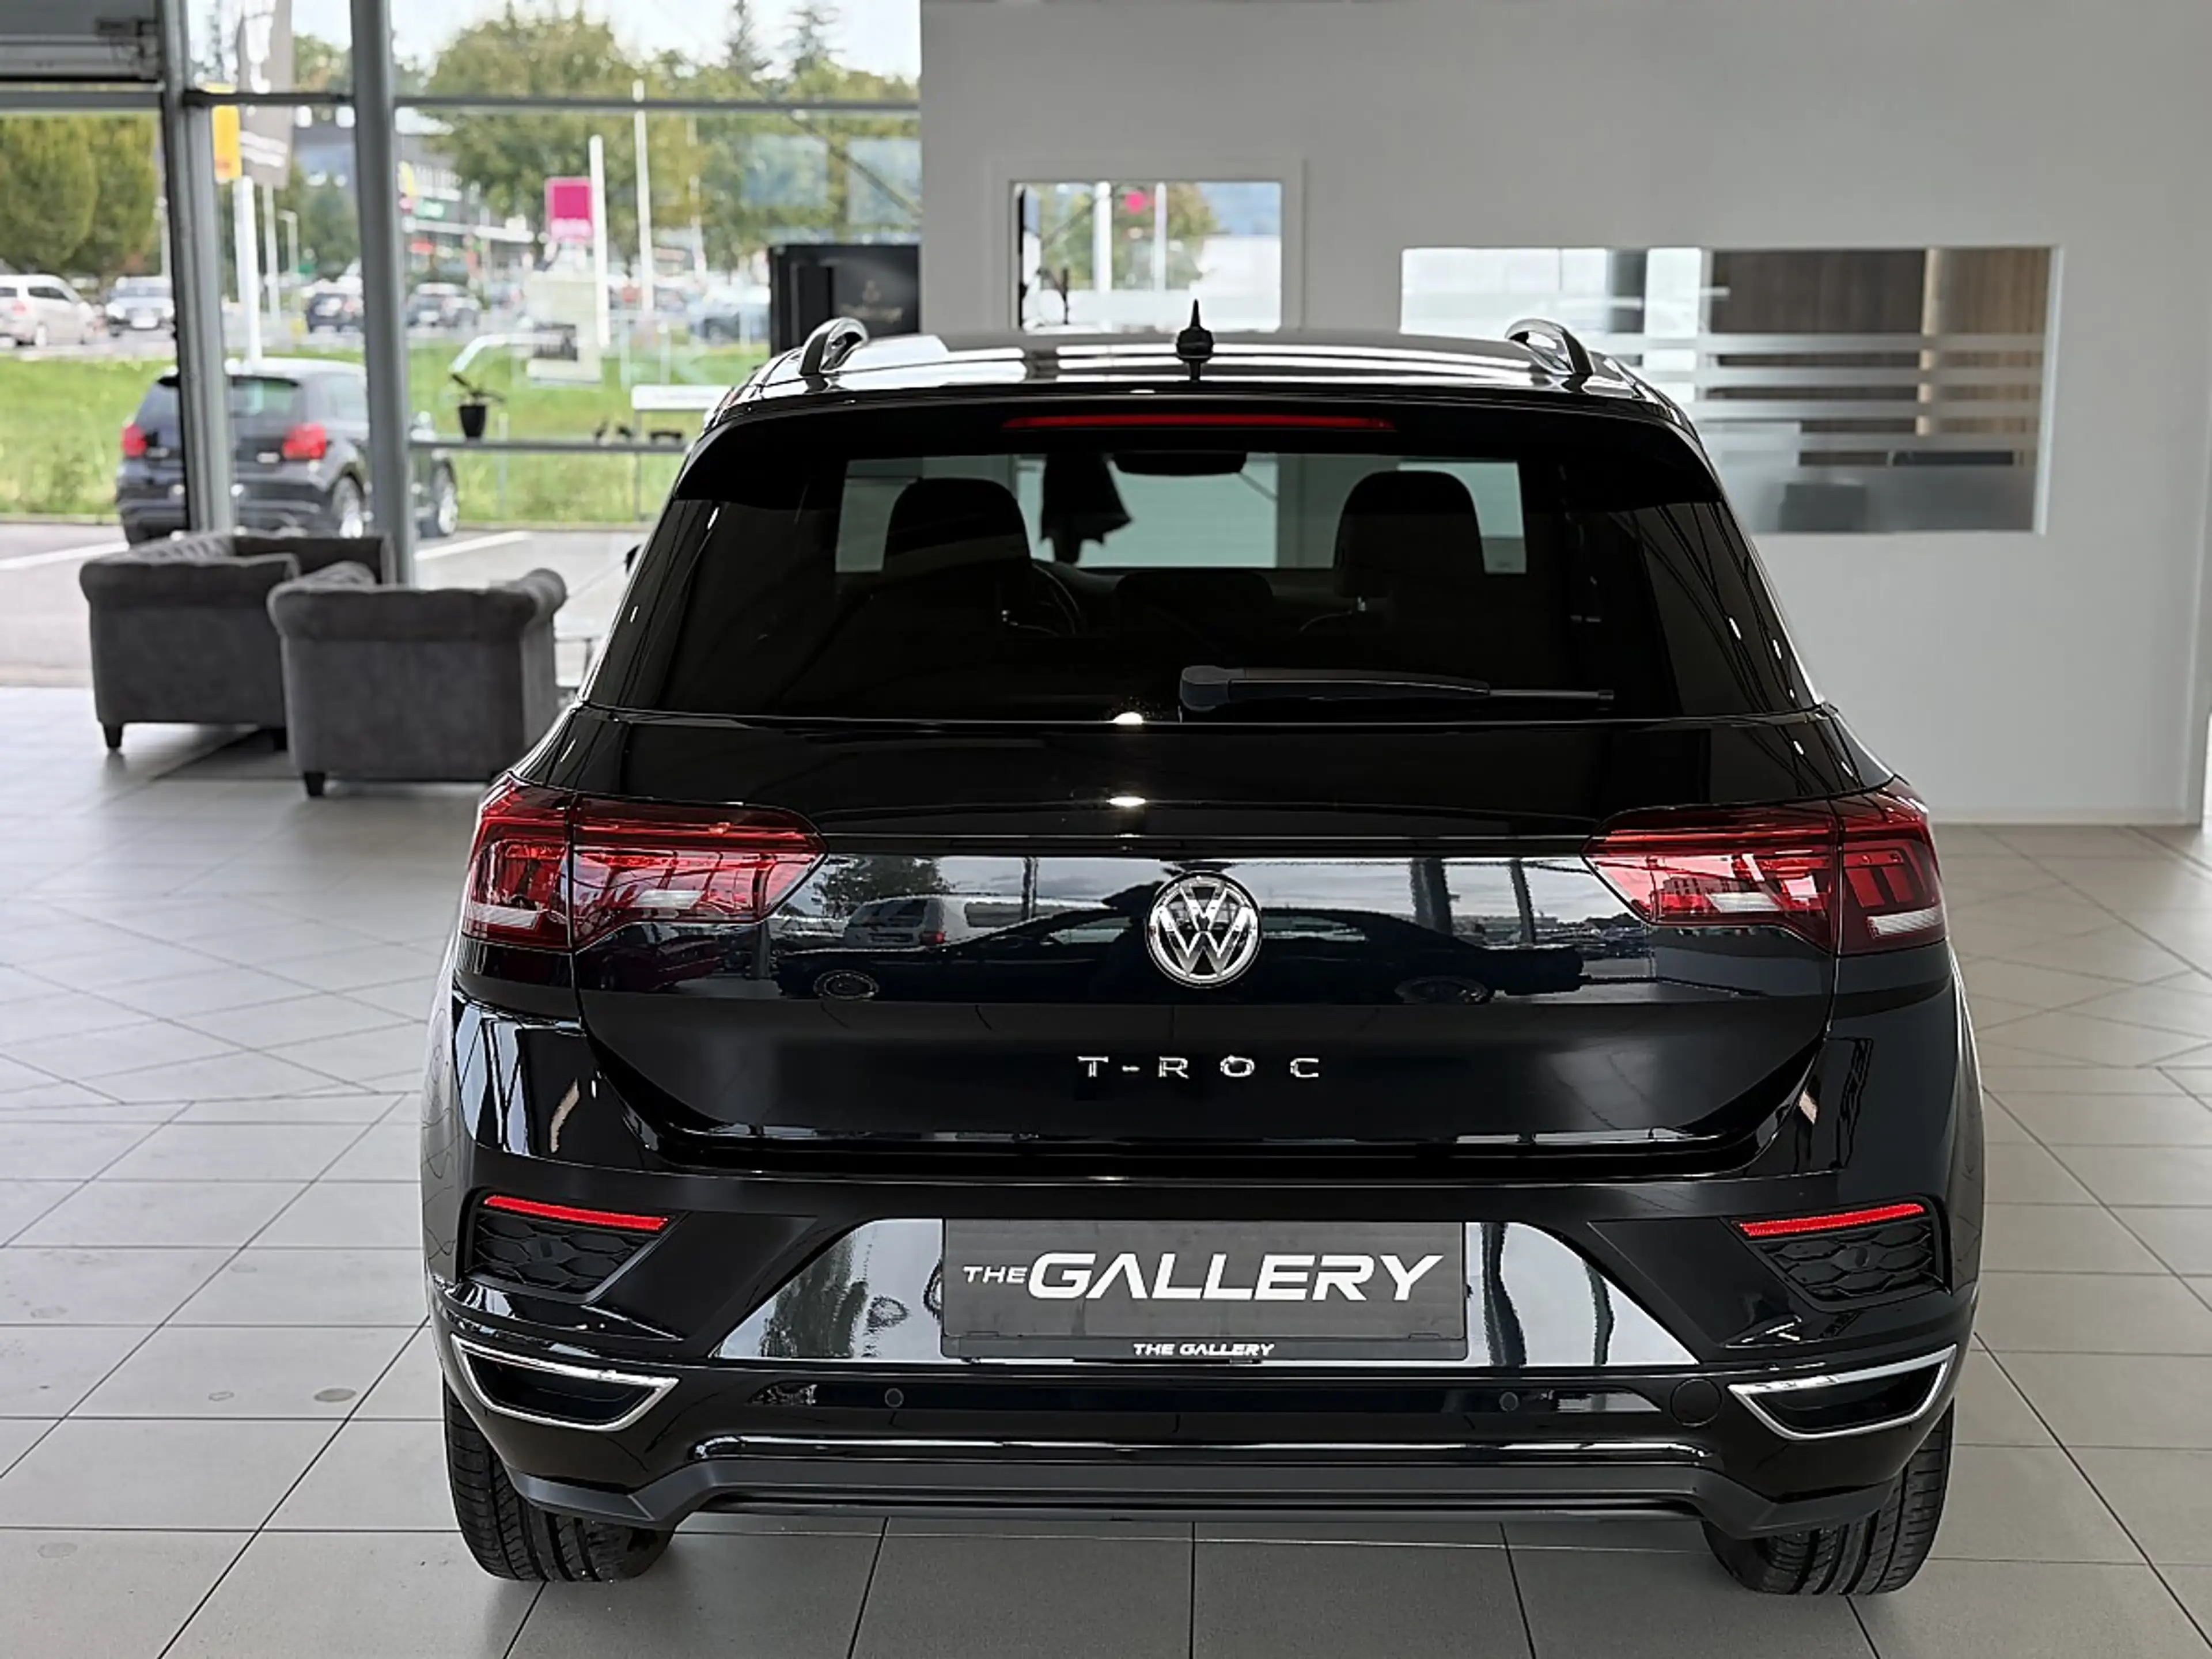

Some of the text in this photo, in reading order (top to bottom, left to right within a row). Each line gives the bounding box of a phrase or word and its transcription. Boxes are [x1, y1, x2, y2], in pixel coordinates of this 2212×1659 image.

[1149, 874, 1259, 984] VW
[1077, 1055, 1320, 1078] T-ROC
[963, 1253, 1444, 1301] THE GALLERY
[1133, 1343, 1275, 1357] THE GALLERY
